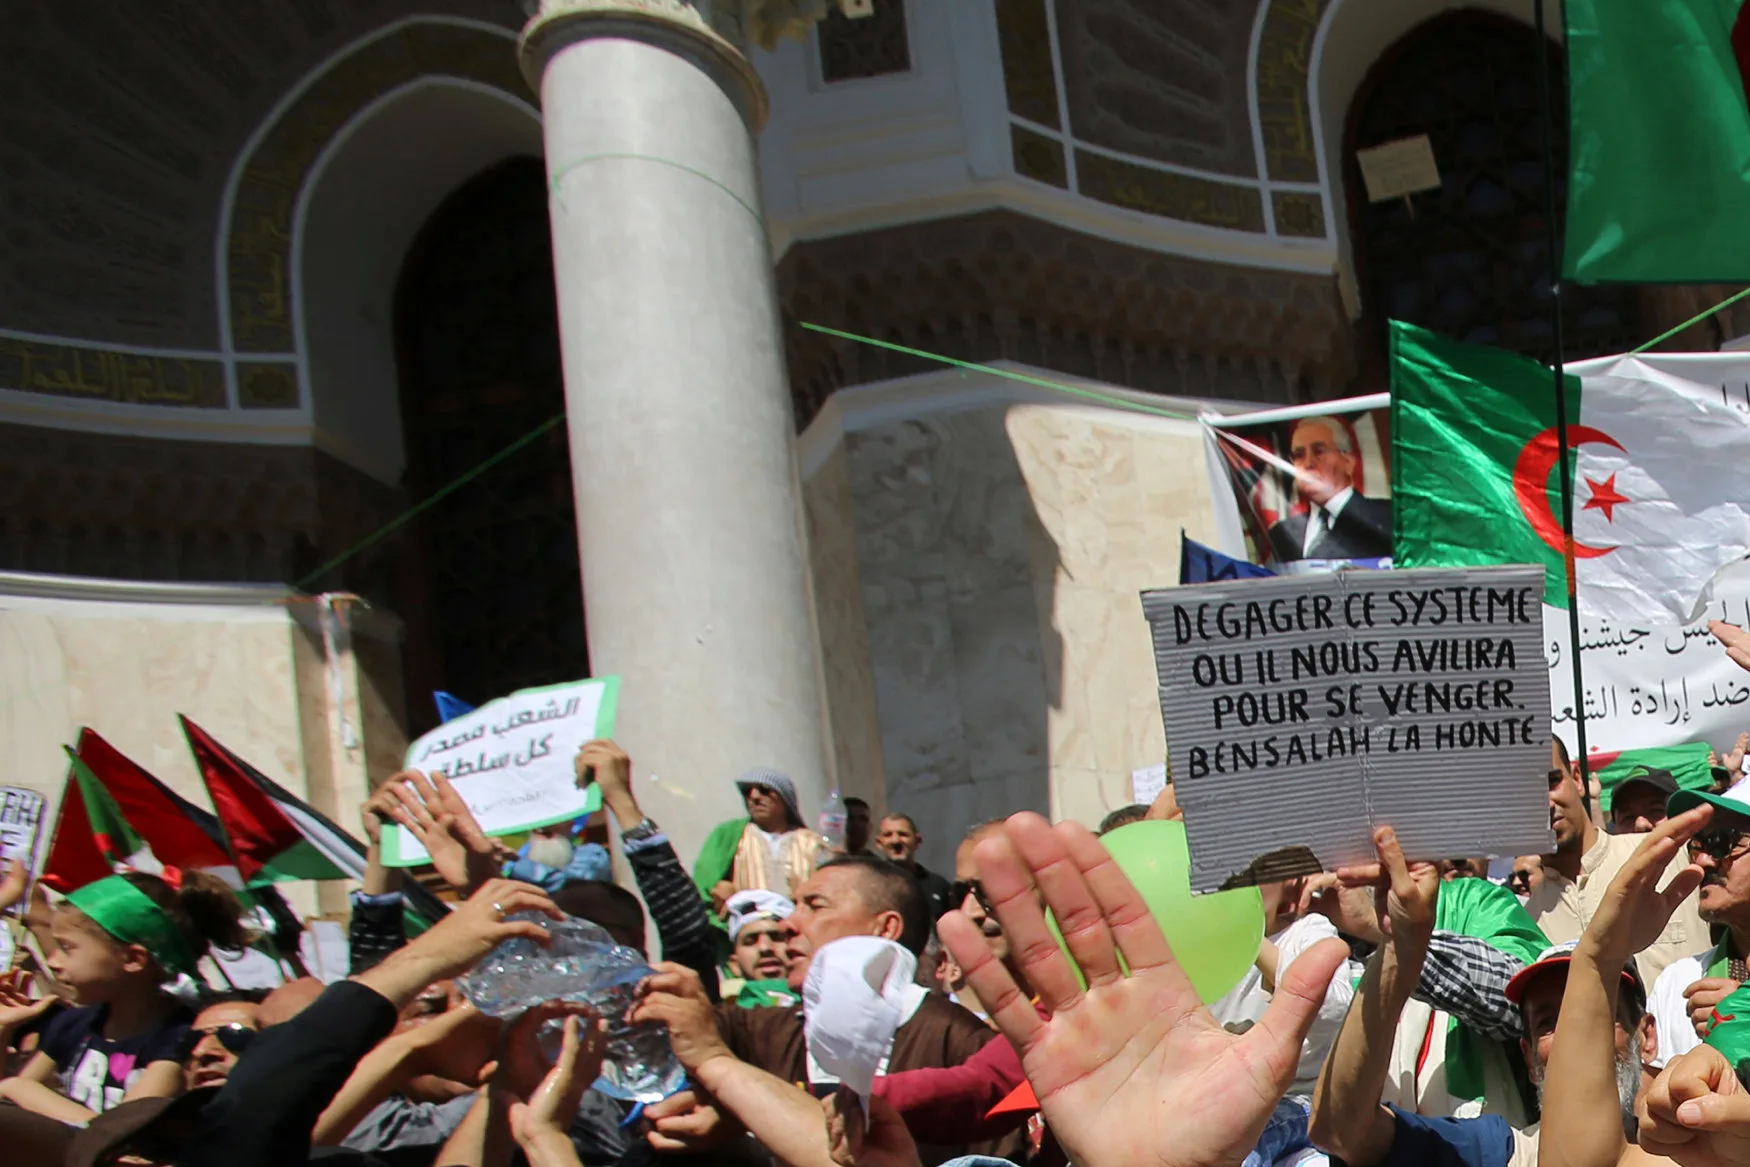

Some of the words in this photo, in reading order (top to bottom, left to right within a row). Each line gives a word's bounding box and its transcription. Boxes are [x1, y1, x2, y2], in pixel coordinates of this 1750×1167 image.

[1173, 594, 1334, 644] DEGAGER
[1344, 591, 1377, 629] CE
[1388, 586, 1533, 626] SYSTEME
[1192, 651, 1244, 688] OU
[1256, 650, 1281, 684] IL
[1291, 639, 1380, 680] NOUS
[1391, 638, 1516, 674] AVILIRA
[492, 697, 581, 739] الشعب
[1212, 687, 1309, 728] POUR
[1326, 683, 1363, 718] SE
[1377, 679, 1526, 717] VENGER.
[1631, 676, 1692, 726] إرادة
[514, 733, 555, 767] كل
[1188, 724, 1371, 780] BENSALAH
[1387, 724, 1421, 753] LA
